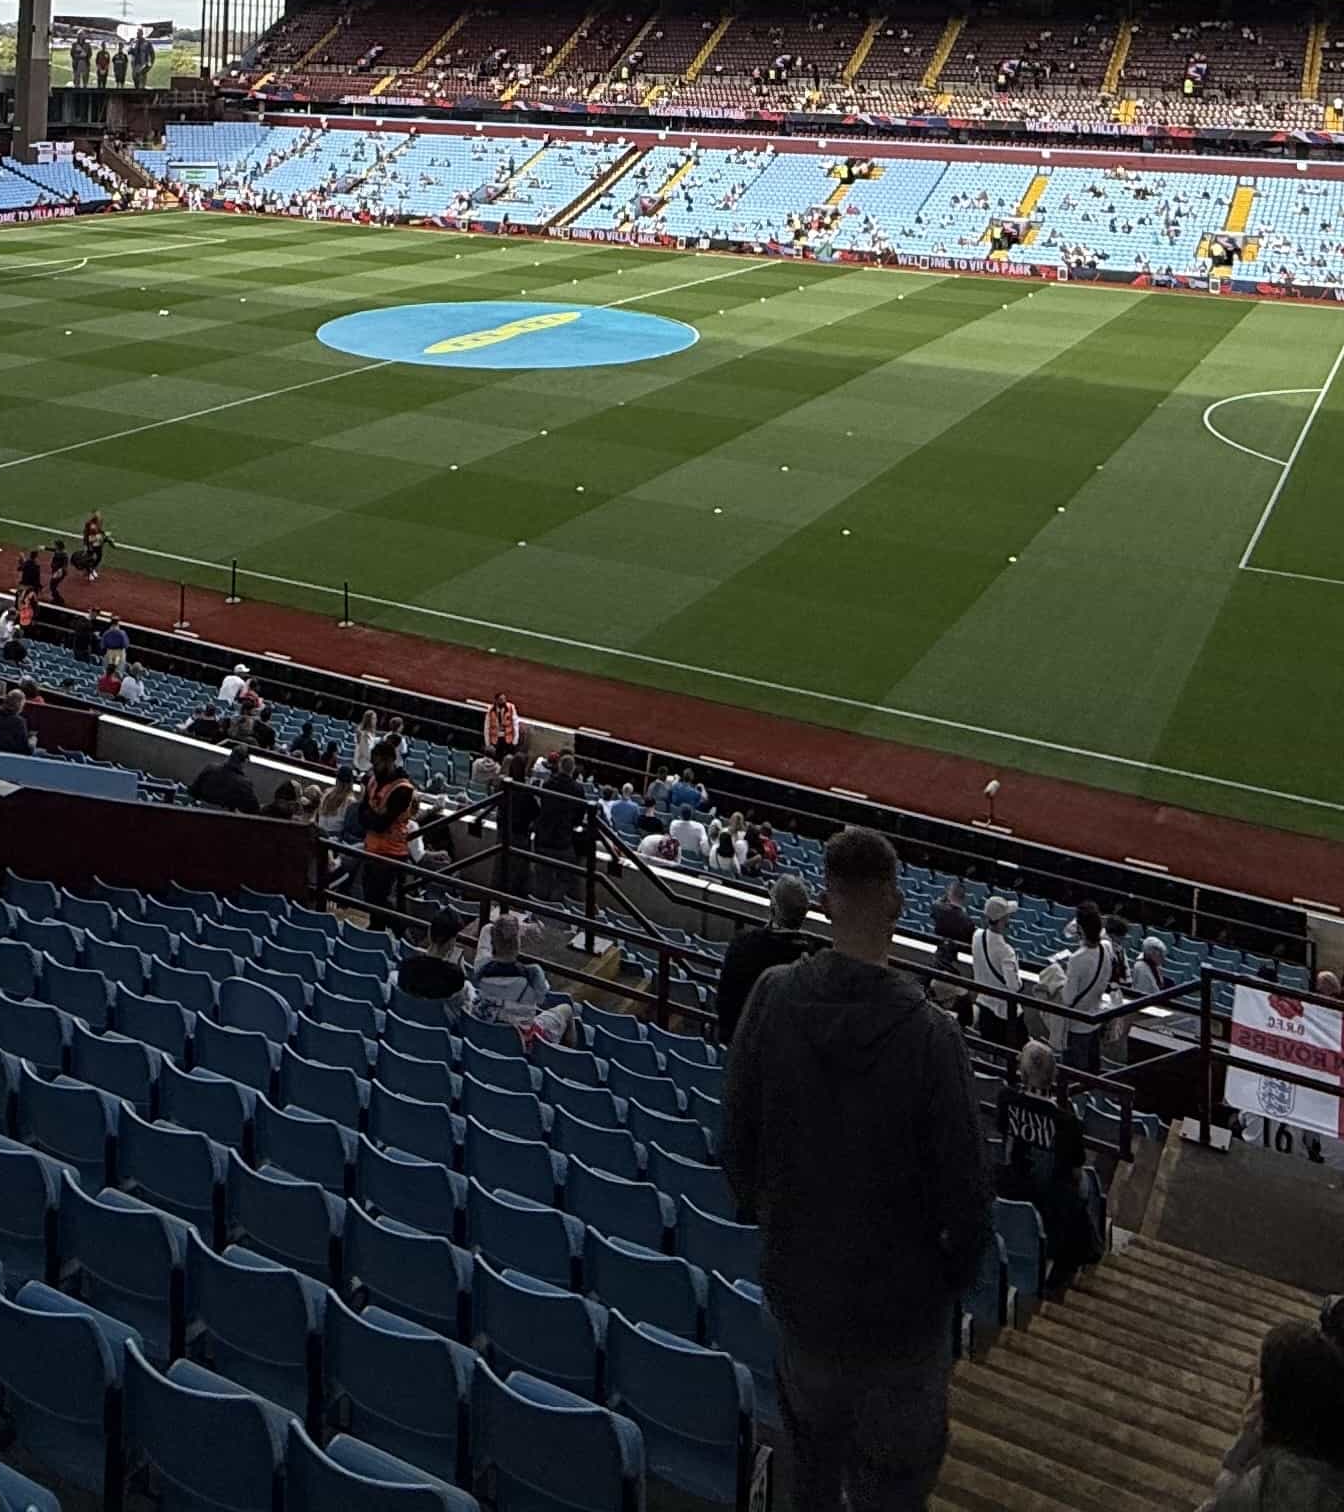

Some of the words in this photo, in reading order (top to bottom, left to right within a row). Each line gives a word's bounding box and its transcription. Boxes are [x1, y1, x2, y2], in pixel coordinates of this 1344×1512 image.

[649, 106, 688, 117] WELCOME
[689, 107, 699, 118] TO
[700, 107, 723, 119] VILLA
[724, 108, 746, 120] PARK
[1025, 117, 1076, 134] WELCOME
[1077, 122, 1090, 134] TO
[1091, 123, 1118, 135] VILLA
[1120, 124, 1148, 136] PARK
[18, 210, 30, 222] TO
[30, 208, 53, 220] VILLA
[54, 206, 76, 218] PARK
[548, 226, 592, 241] WEOME
[594, 229, 605, 241] TO
[606, 230, 630, 243] VILLA
[897, 254, 952, 270] WELME
[953, 259, 967, 271] TO
[968, 259, 999, 273] VILLA
[1001, 262, 1032, 276] PARK
